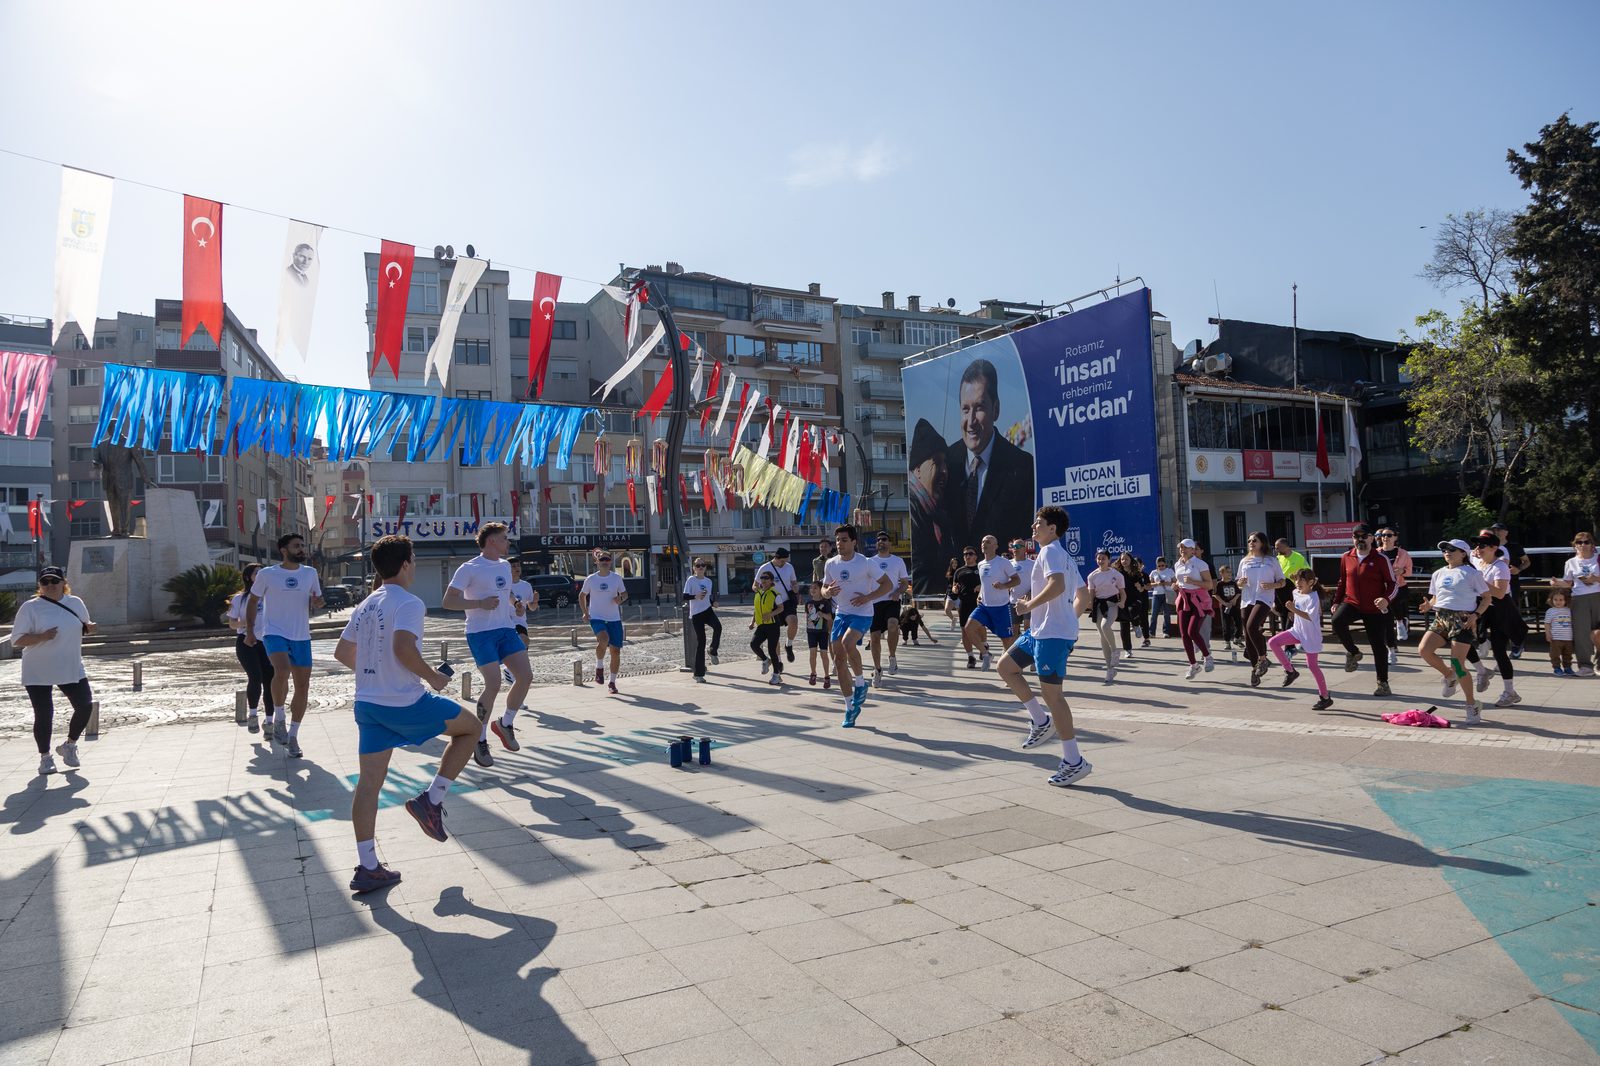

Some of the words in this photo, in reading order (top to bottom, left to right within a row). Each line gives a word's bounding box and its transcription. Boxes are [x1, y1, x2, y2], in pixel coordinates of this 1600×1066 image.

[1065, 339, 1105, 358] Rotamız
[1062, 380, 1113, 400] rehberimiz
[1070, 465, 1115, 483] VİCDAN
[1051, 478, 1140, 503] BELEDİYECİLİĞİ
[454, 520, 517, 536] İMM
[1102, 529, 1126, 547] Bora
[1223, 587, 1235, 596] 98
